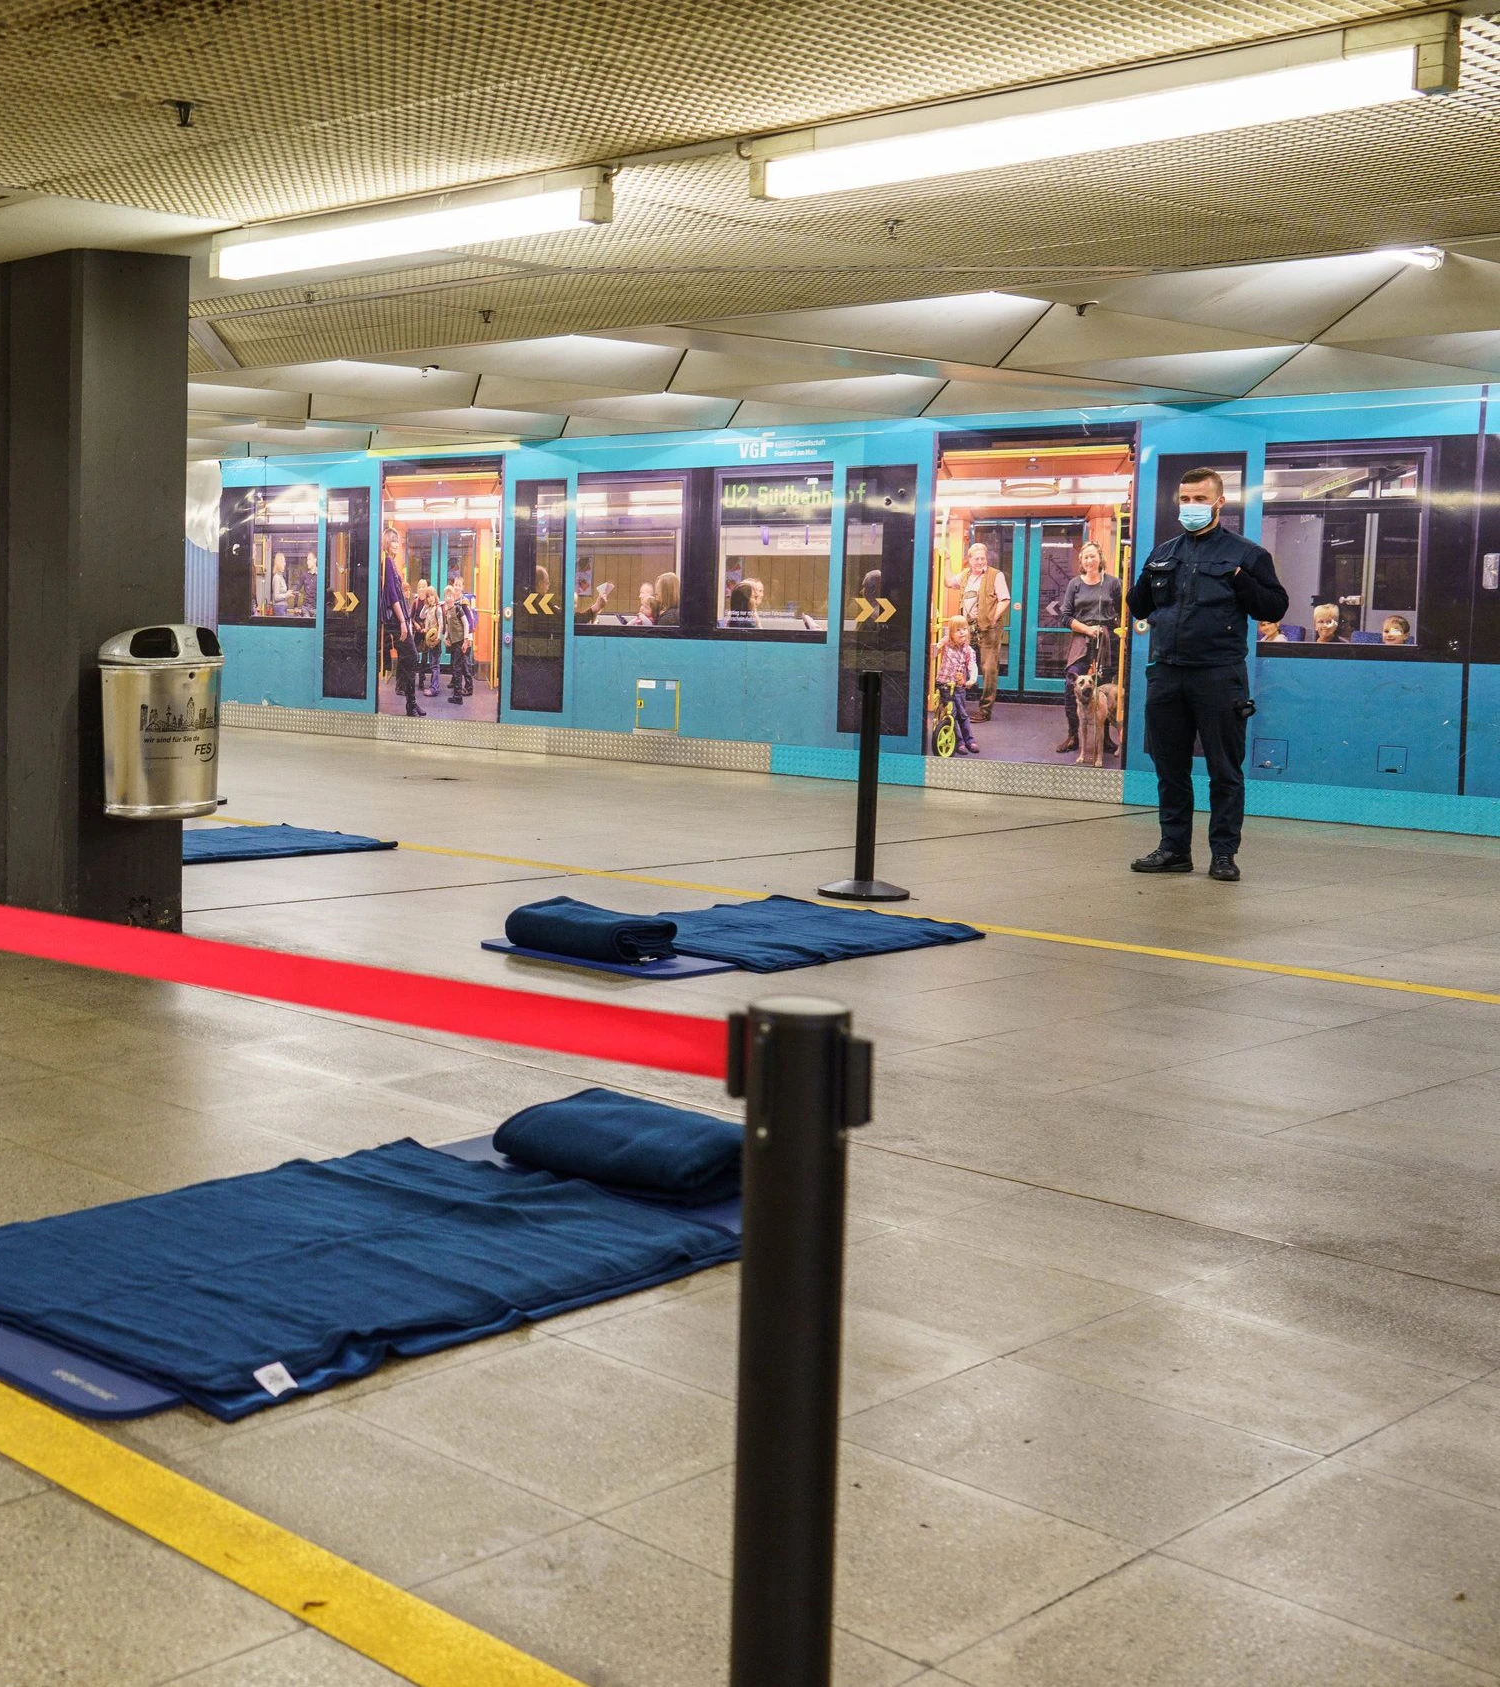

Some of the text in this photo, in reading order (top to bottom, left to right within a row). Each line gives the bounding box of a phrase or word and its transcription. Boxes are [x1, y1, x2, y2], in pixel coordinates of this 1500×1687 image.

[739, 431, 776, 459] VGF
[724, 484, 749, 508] U2
[156, 735, 171, 743] sind
[194, 743, 212, 755] FES
